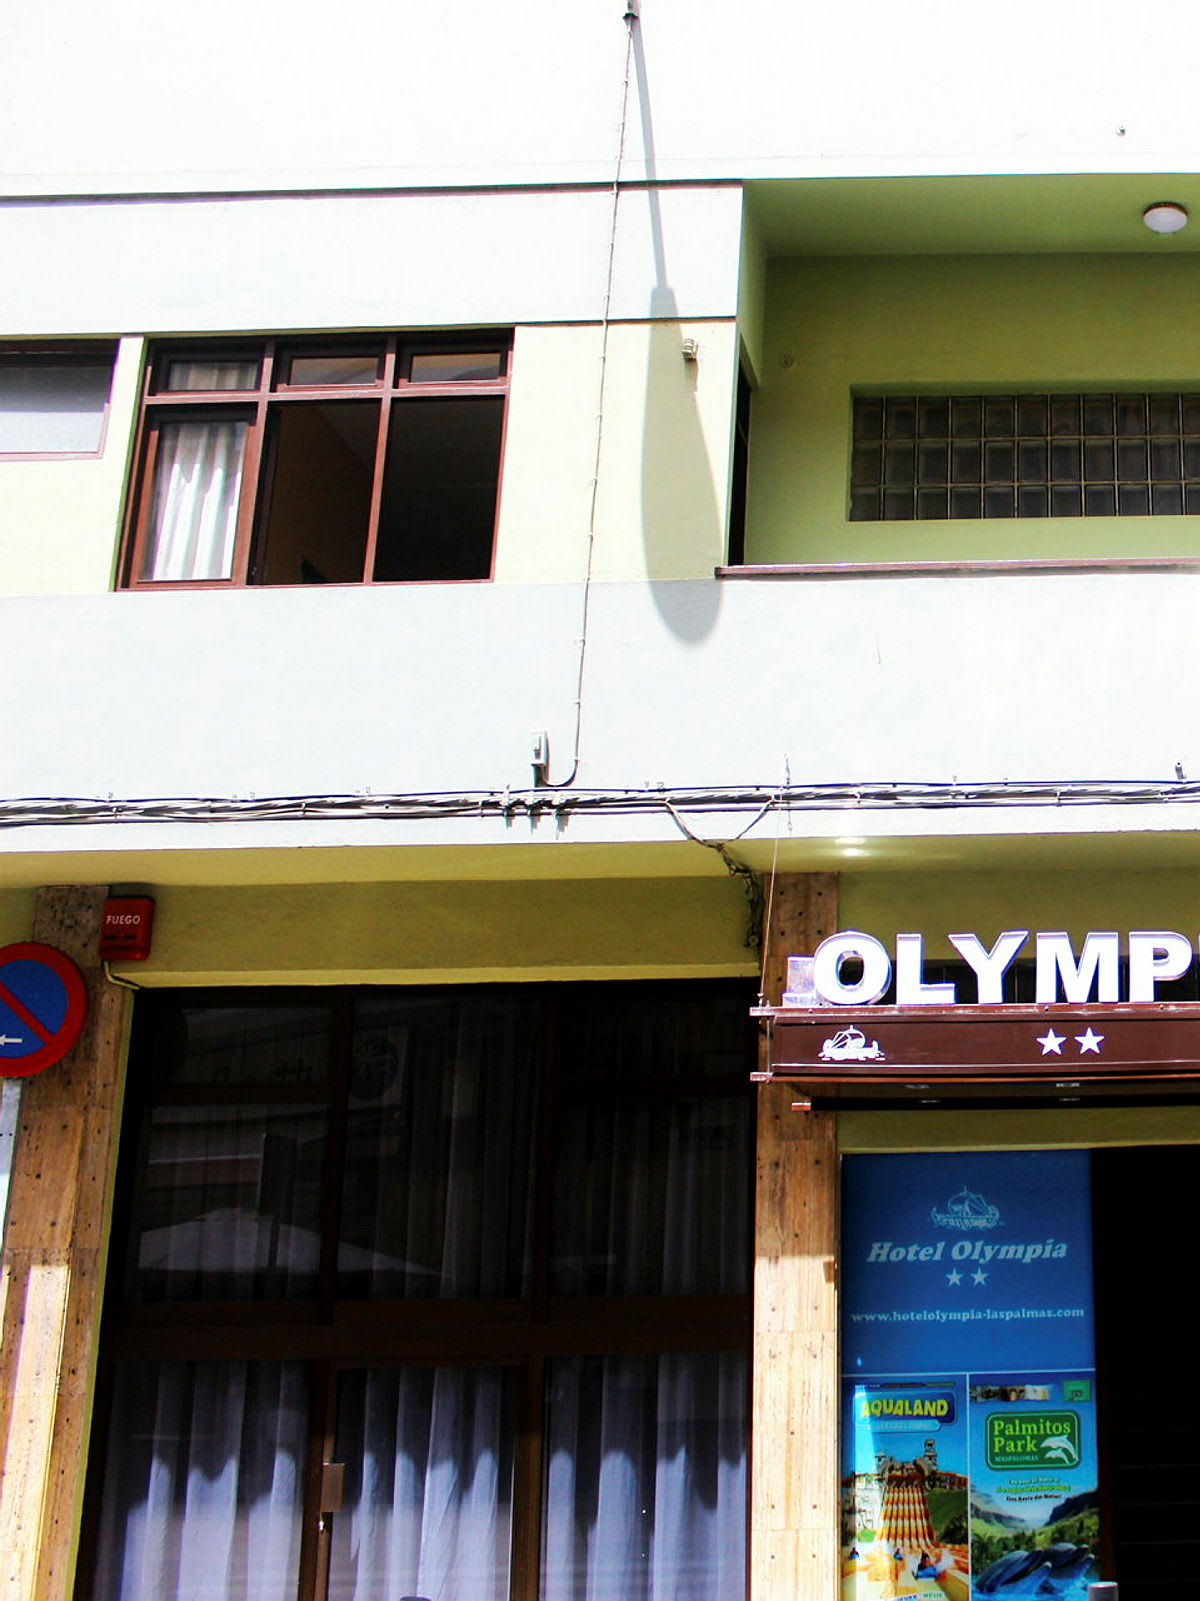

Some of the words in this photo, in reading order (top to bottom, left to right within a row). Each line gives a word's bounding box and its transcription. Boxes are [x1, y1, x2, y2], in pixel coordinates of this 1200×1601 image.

[105, 914, 141, 925] FUEGO
[866, 1240, 946, 1263] Hotel
[951, 1238, 1068, 1265] Olympia
[850, 1307, 1085, 1323] www.hotelolympia-laspalmas.com
[860, 1397, 949, 1418] AQUALAND
[993, 1418, 1072, 1436] Palmitos
[993, 1435, 1039, 1453] Park
